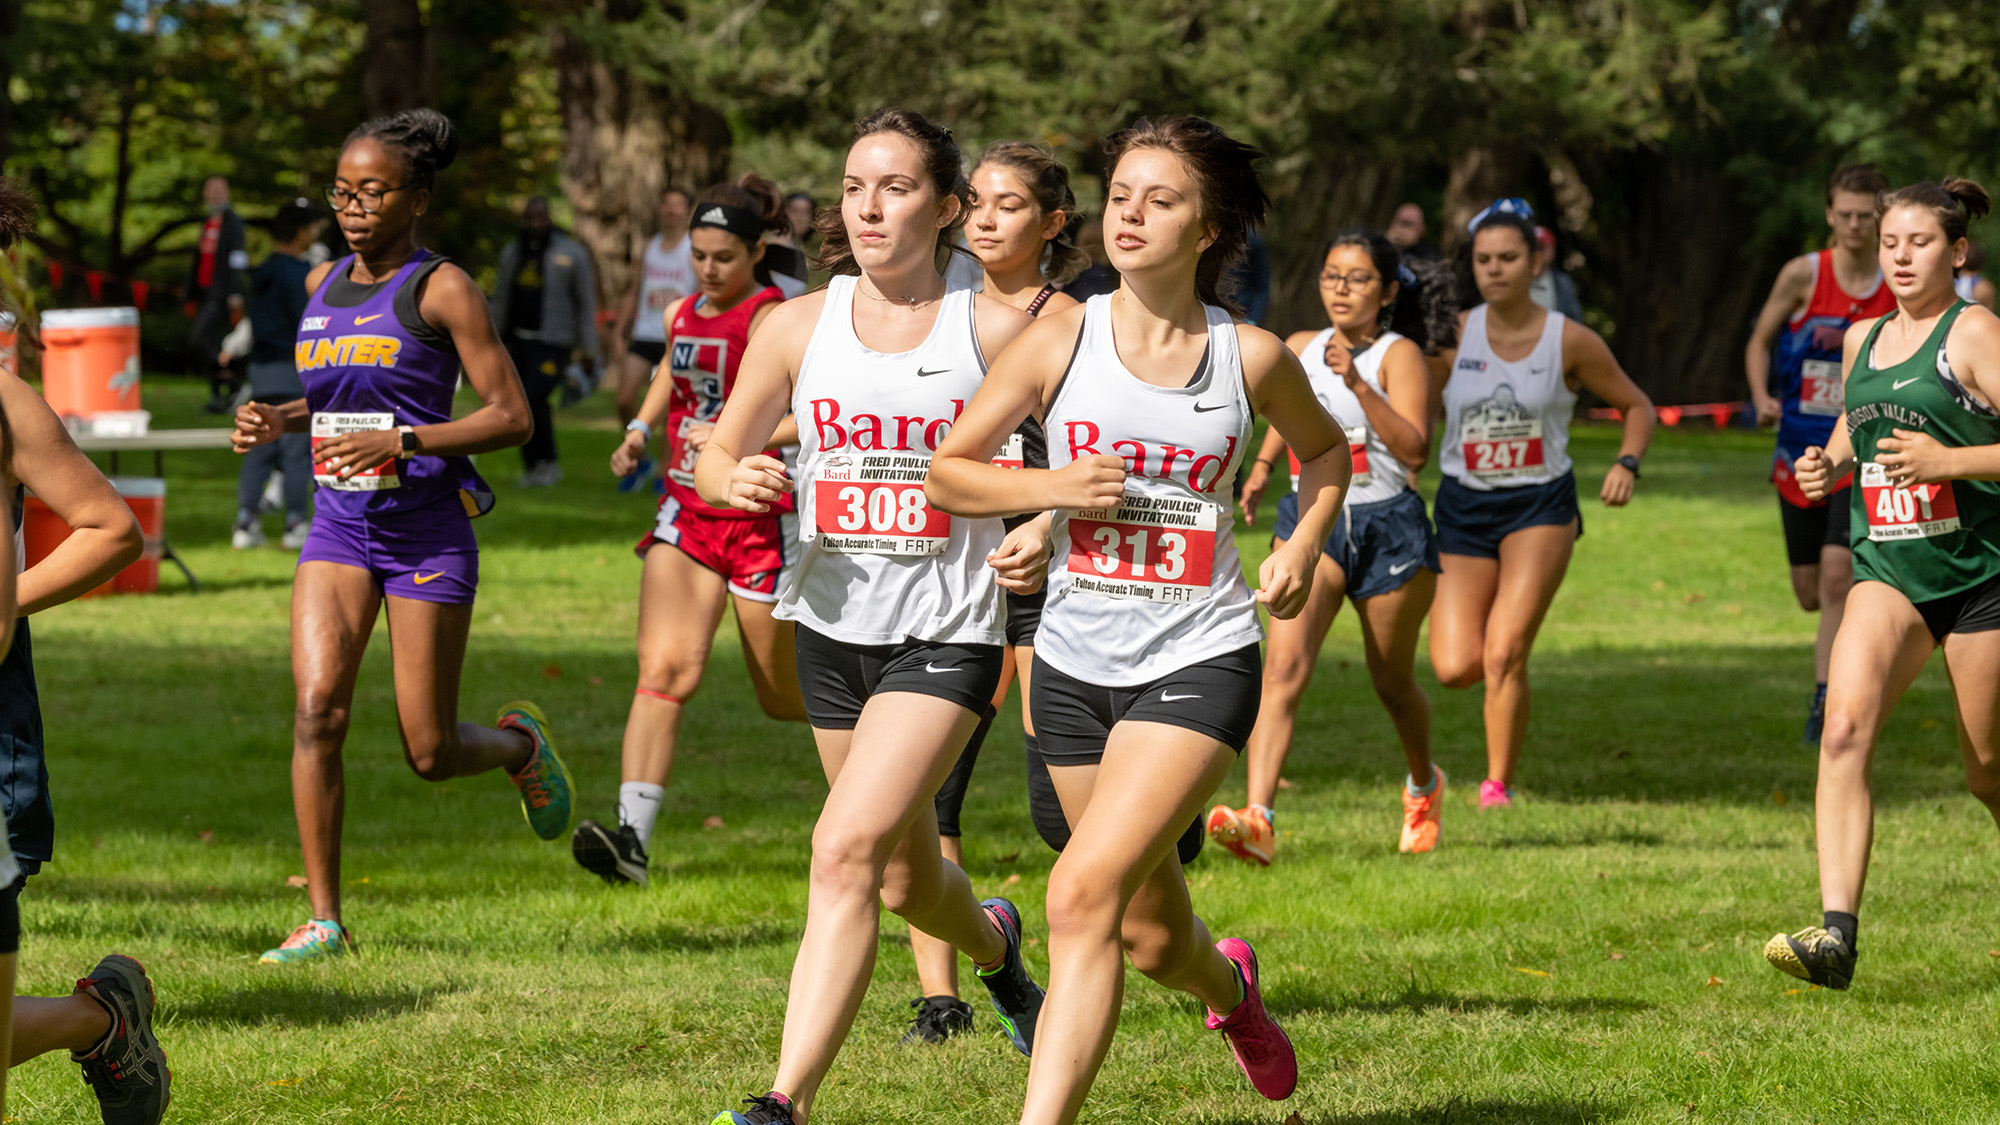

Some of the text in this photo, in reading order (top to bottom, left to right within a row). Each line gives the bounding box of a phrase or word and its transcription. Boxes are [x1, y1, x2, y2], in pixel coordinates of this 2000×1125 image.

[295, 334, 402, 373] HUNTER
[1812, 380, 1845, 404] 28
[810, 398, 964, 452] Bard
[1880, 402, 1928, 429] VALLEY
[862, 456, 932, 469] FRED PAVLIC
[1064, 421, 1237, 493] Bard
[1475, 441, 1529, 469] 247
[824, 469, 851, 481] Bard
[859, 468, 929, 481] INVITATION
[837, 486, 927, 533] 308
[1121, 496, 1203, 513] FRED PAVLICH
[1876, 484, 1933, 523] 401
[1116, 509, 1198, 526] INVITATIONAL
[823, 537, 843, 549] Fulton
[844, 538, 874, 549] Accurate
[875, 539, 897, 552] Timing
[1092, 526, 1187, 581] 313
[1075, 577, 1095, 591] Fulton
[1096, 581, 1128, 595] Accurate
[1129, 584, 1154, 600] Timing
